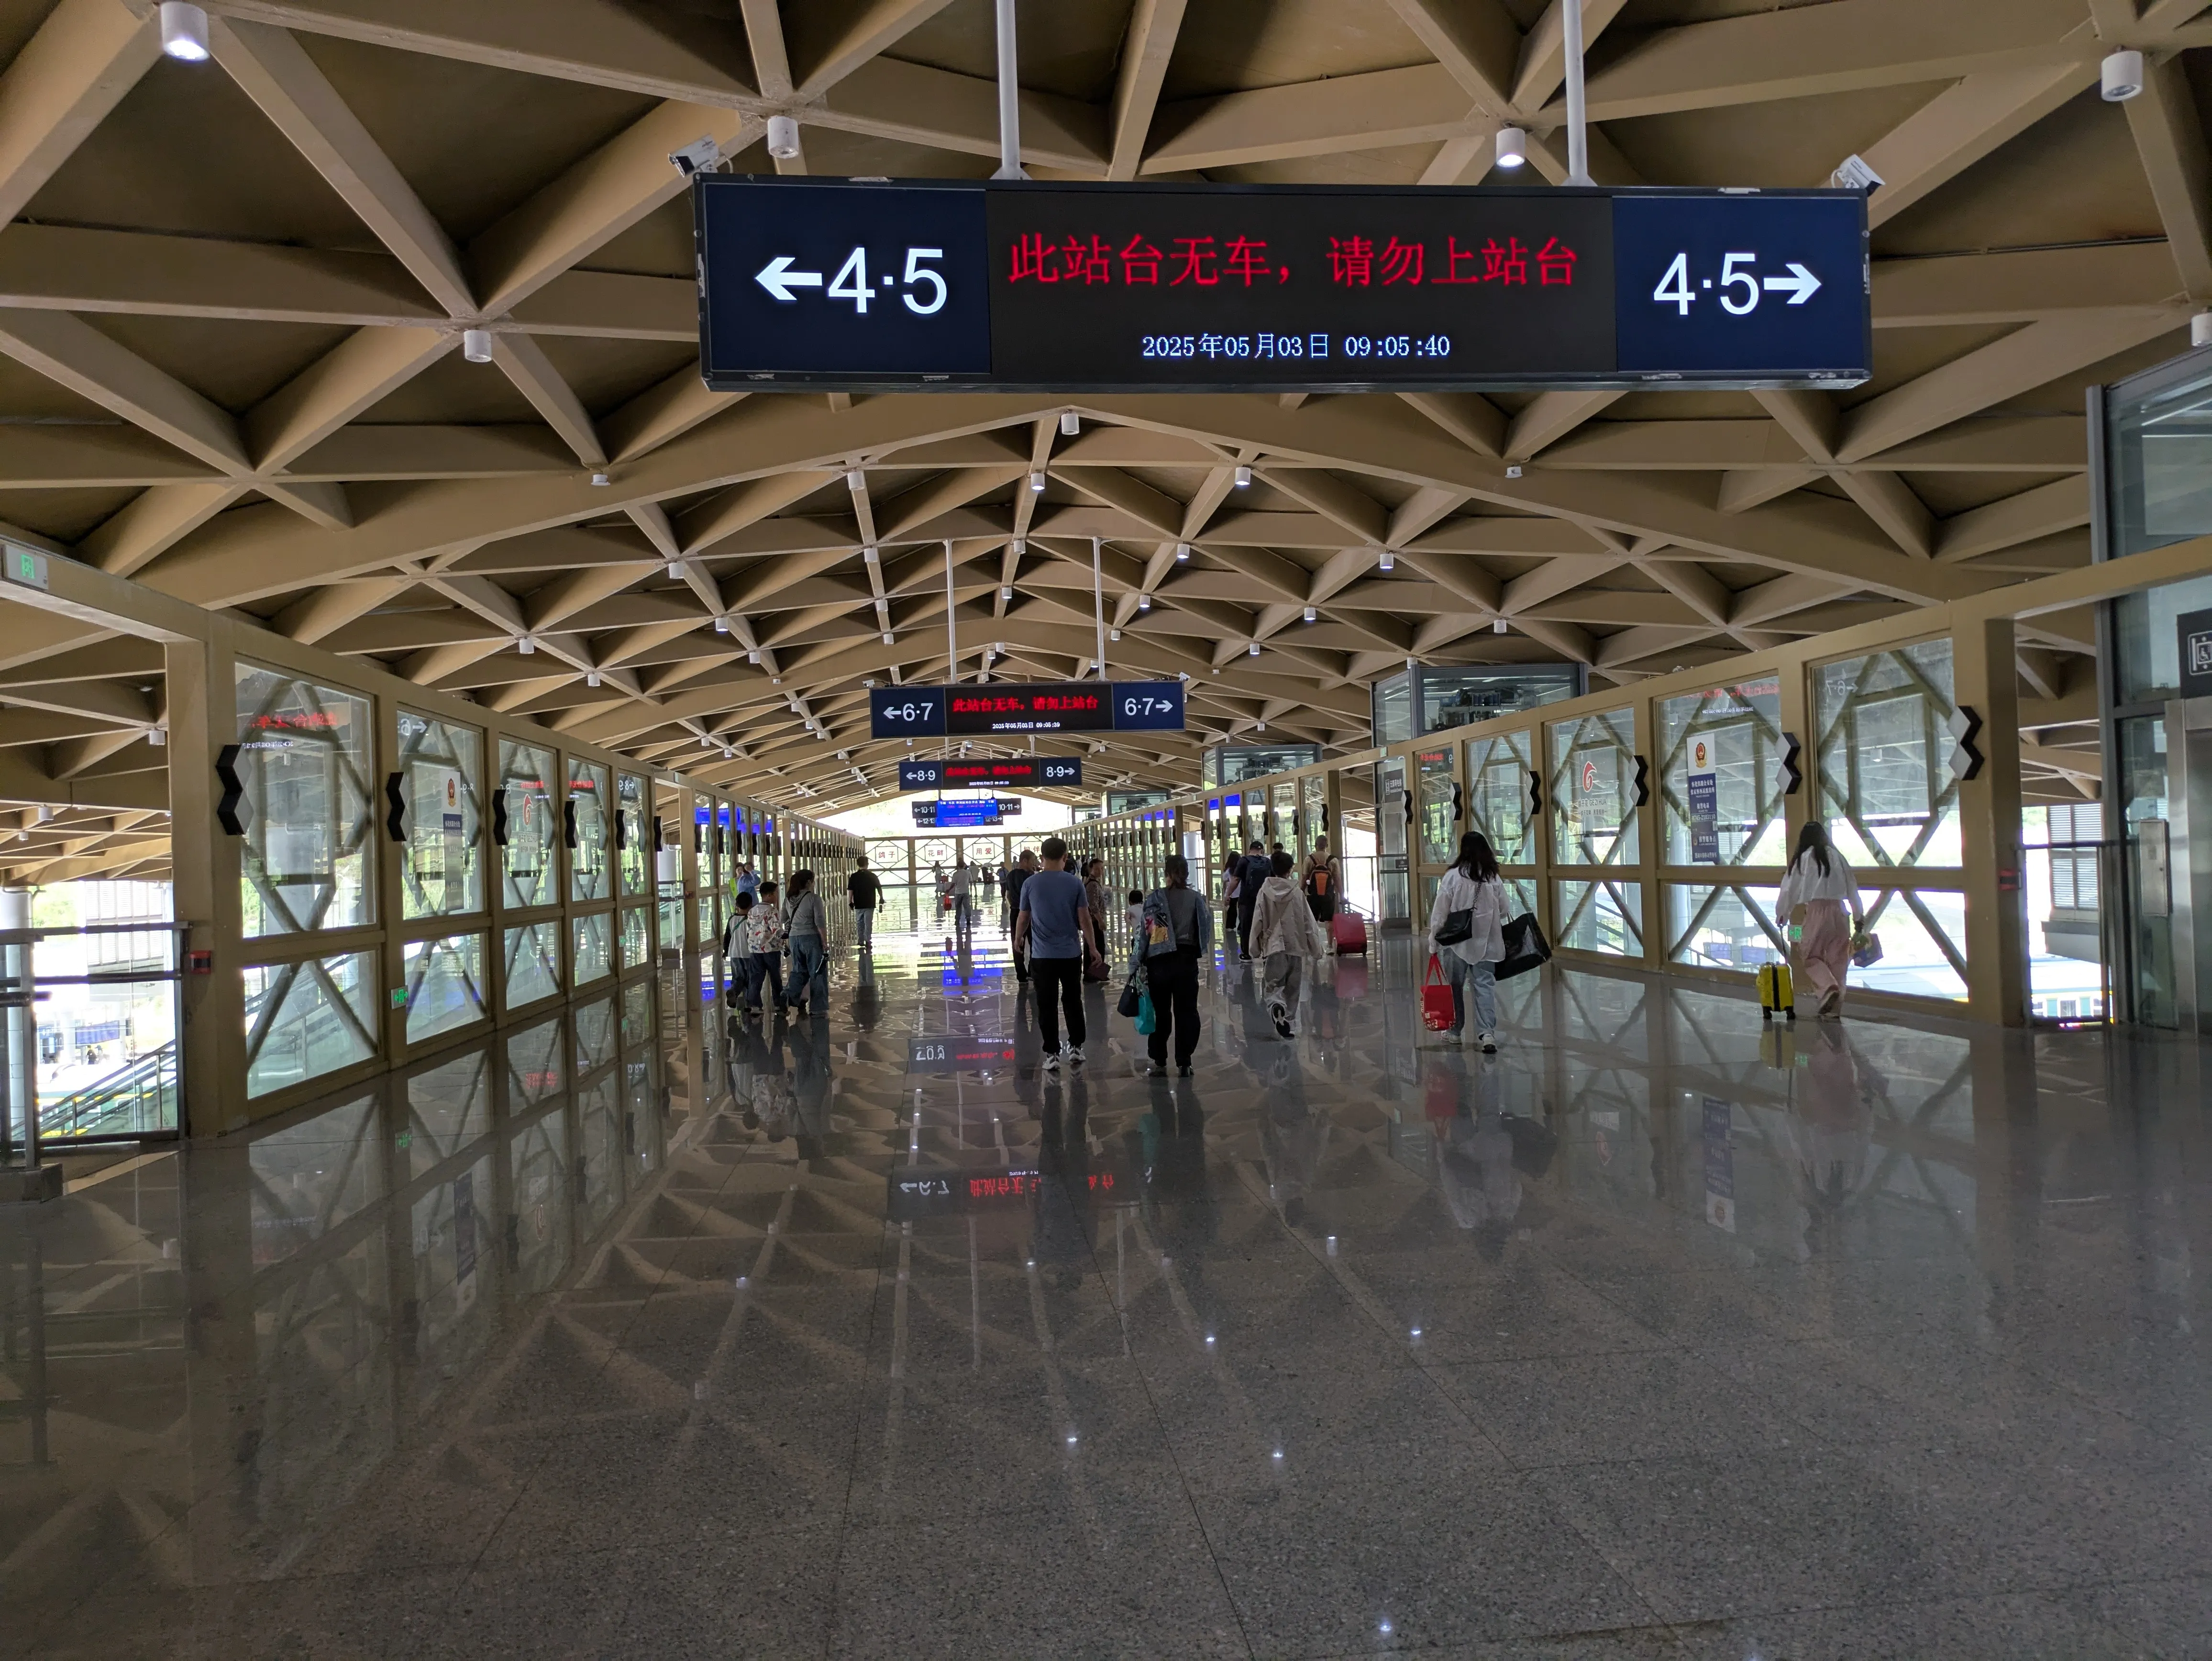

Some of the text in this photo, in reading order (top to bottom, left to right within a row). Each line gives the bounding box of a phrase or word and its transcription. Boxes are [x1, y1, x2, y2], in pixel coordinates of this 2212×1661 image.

[1008, 233, 1577, 287] 此站台无车，请勿上站台
[1142, 333, 1450, 359] 2025年05月03日 09:05:40
